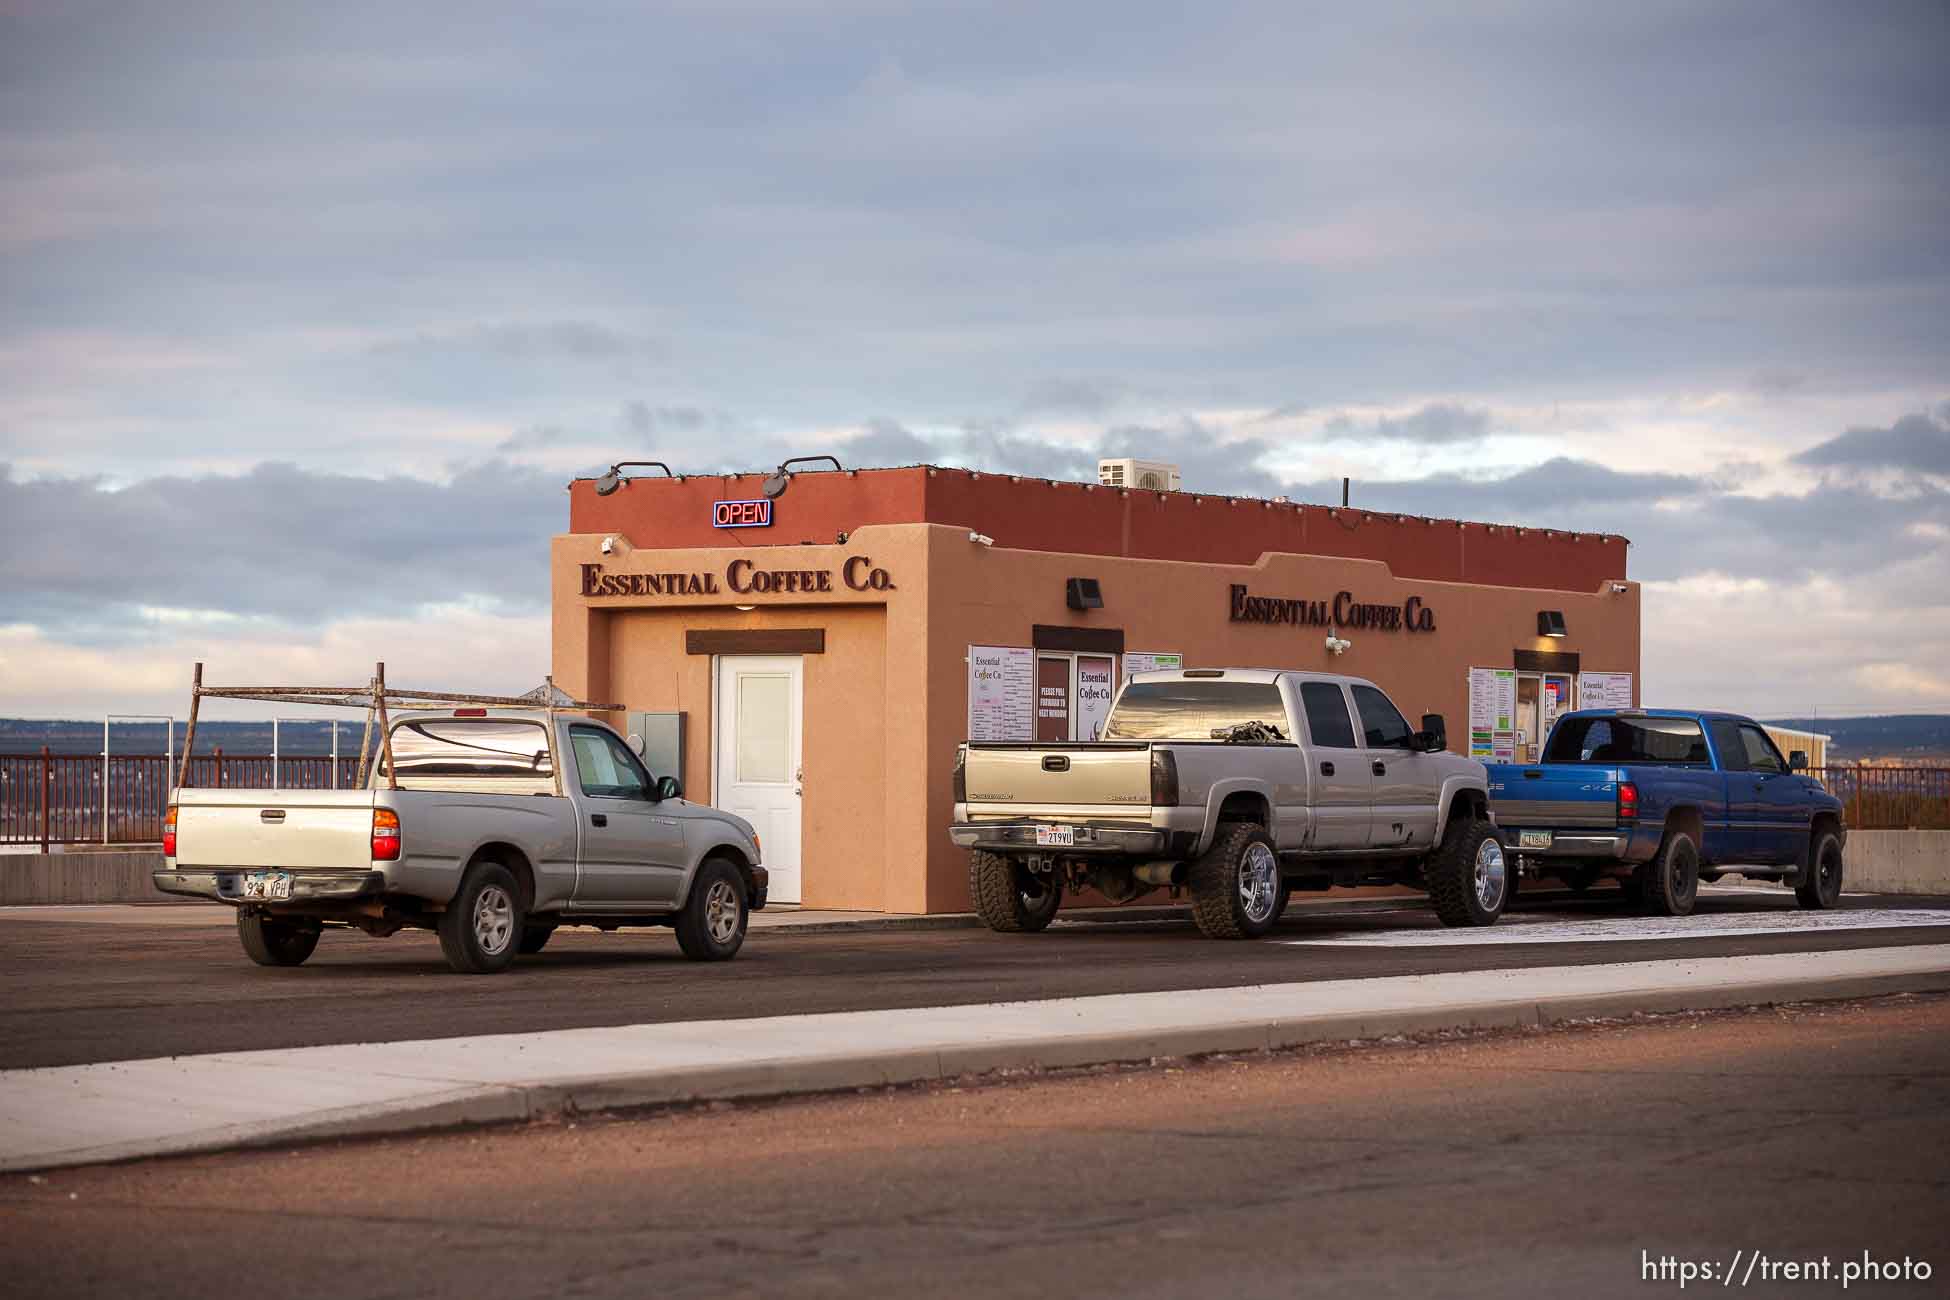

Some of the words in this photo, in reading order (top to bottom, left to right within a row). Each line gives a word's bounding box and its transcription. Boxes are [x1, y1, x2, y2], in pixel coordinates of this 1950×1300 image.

[716, 503, 767, 524] OPEN
[579, 564, 719, 596] ESSENTIAL
[727, 559, 832, 593] COFFEE
[843, 556, 897, 591] CO.
[1230, 584, 1331, 626] ESSENTIAL
[1334, 591, 1402, 631] COFFEE
[976, 656, 1000, 666] Essential
[1081, 672, 1109, 683] Essential
[1080, 686, 1099, 700] Coffee
